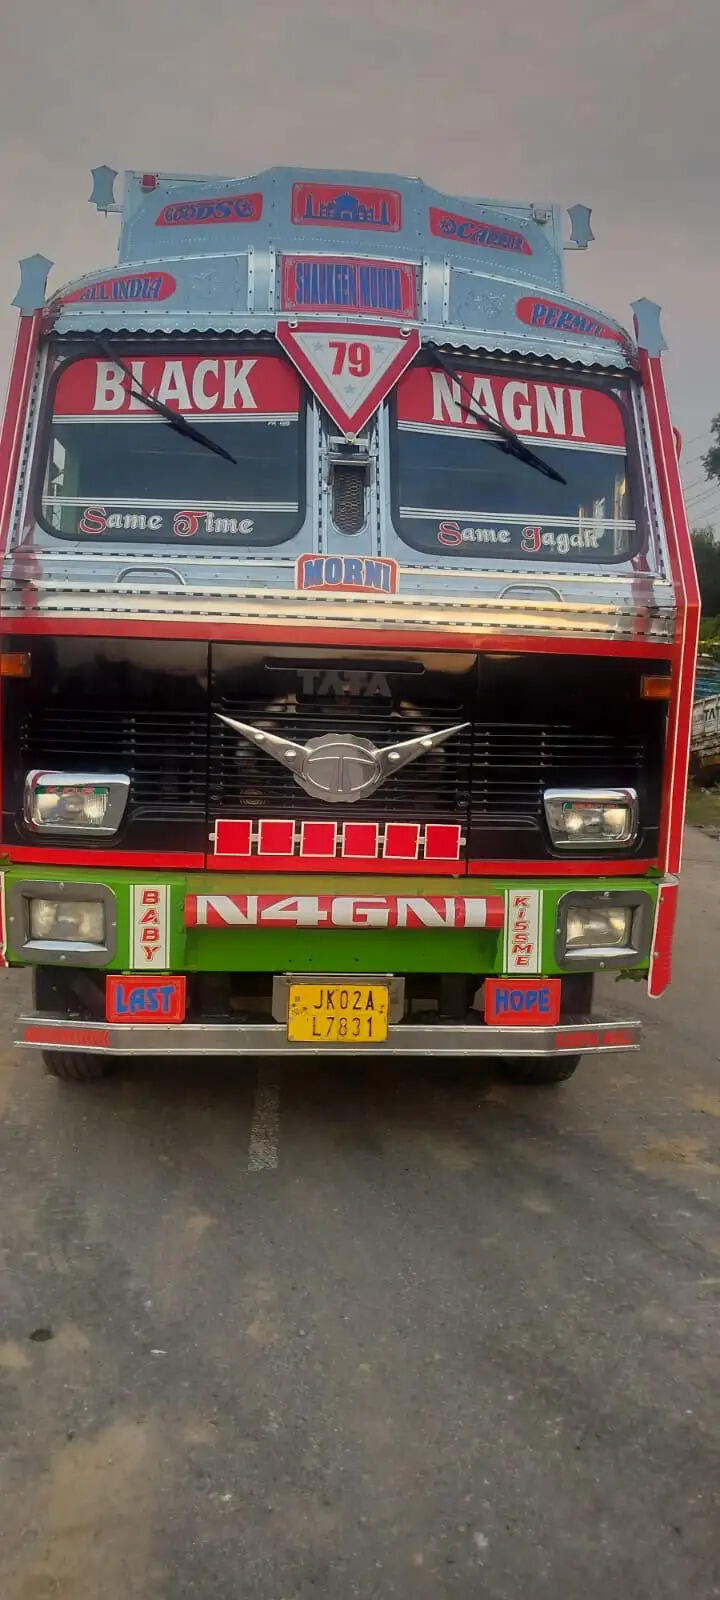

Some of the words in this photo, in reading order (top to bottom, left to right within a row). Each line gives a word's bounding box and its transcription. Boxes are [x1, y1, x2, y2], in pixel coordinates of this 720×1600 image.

[80, 284, 109, 300] ALL
[112, 276, 163, 300] INDIA
[328, 341, 371, 377] 79
[92, 359, 258, 411] BLACK
[430, 371, 586, 438] NAGNI
[80, 505, 164, 534] Same
[173, 511, 255, 537] Time
[437, 521, 512, 546] Same
[303, 557, 391, 593] MORNI
[296, 670, 392, 697] TATA
[139, 890, 161, 961] BABY
[195, 895, 487, 928] N4GNI
[115, 983, 177, 1016] LAST
[313, 989, 374, 1011] JK02A
[495, 988, 551, 1015] HOPE
[312, 1016, 373, 1037] L7831
